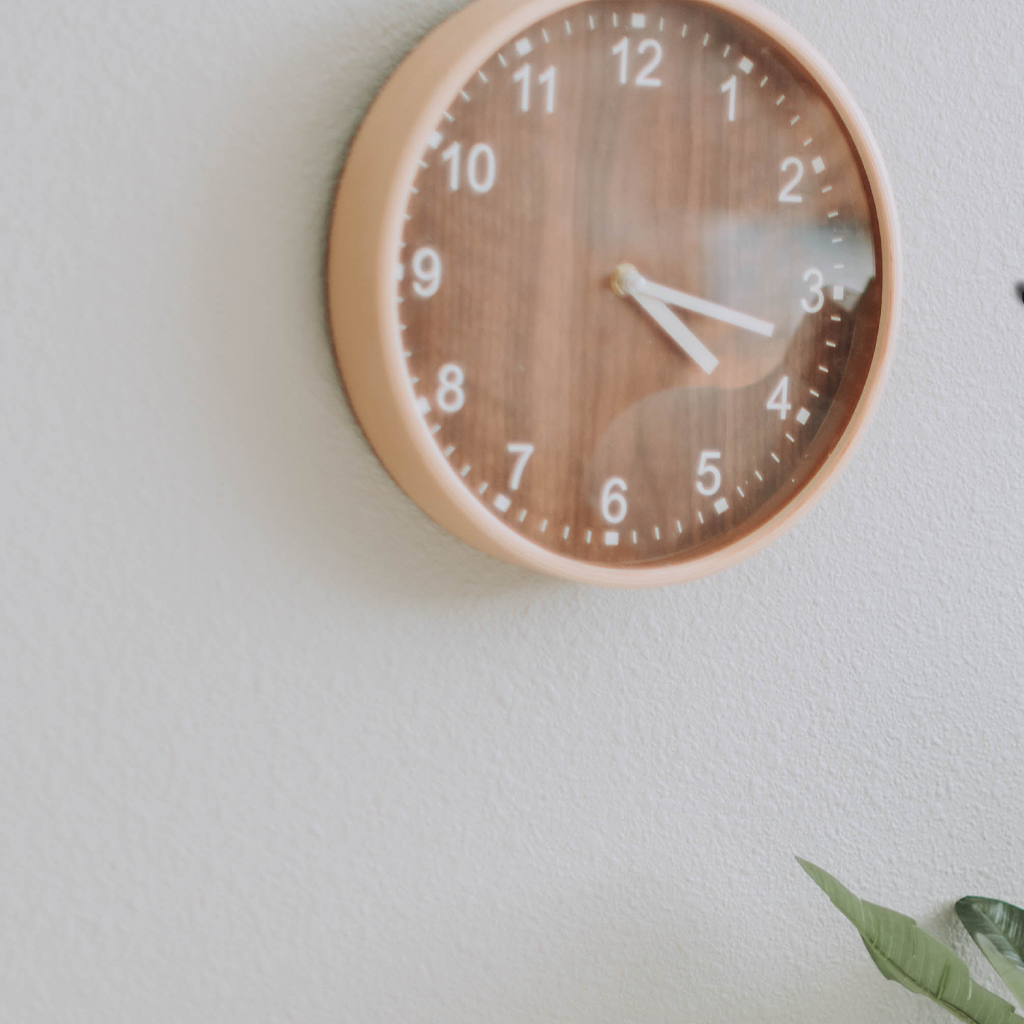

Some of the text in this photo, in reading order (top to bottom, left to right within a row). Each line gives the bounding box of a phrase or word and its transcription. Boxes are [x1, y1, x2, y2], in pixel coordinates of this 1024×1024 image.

[611, 37, 663, 88] 12
[513, 65, 557, 114] 11
[721, 75, 738, 122] 1
[441, 142, 496, 193] 10
[777, 157, 804, 204] 2
[411, 247, 443, 298] 9
[801, 268, 826, 314] 3
[435, 364, 465, 415] 8
[766, 376, 792, 420] 4
[507, 444, 535, 490] 7
[696, 450, 722, 496] 5
[601, 476, 629, 524] 6
